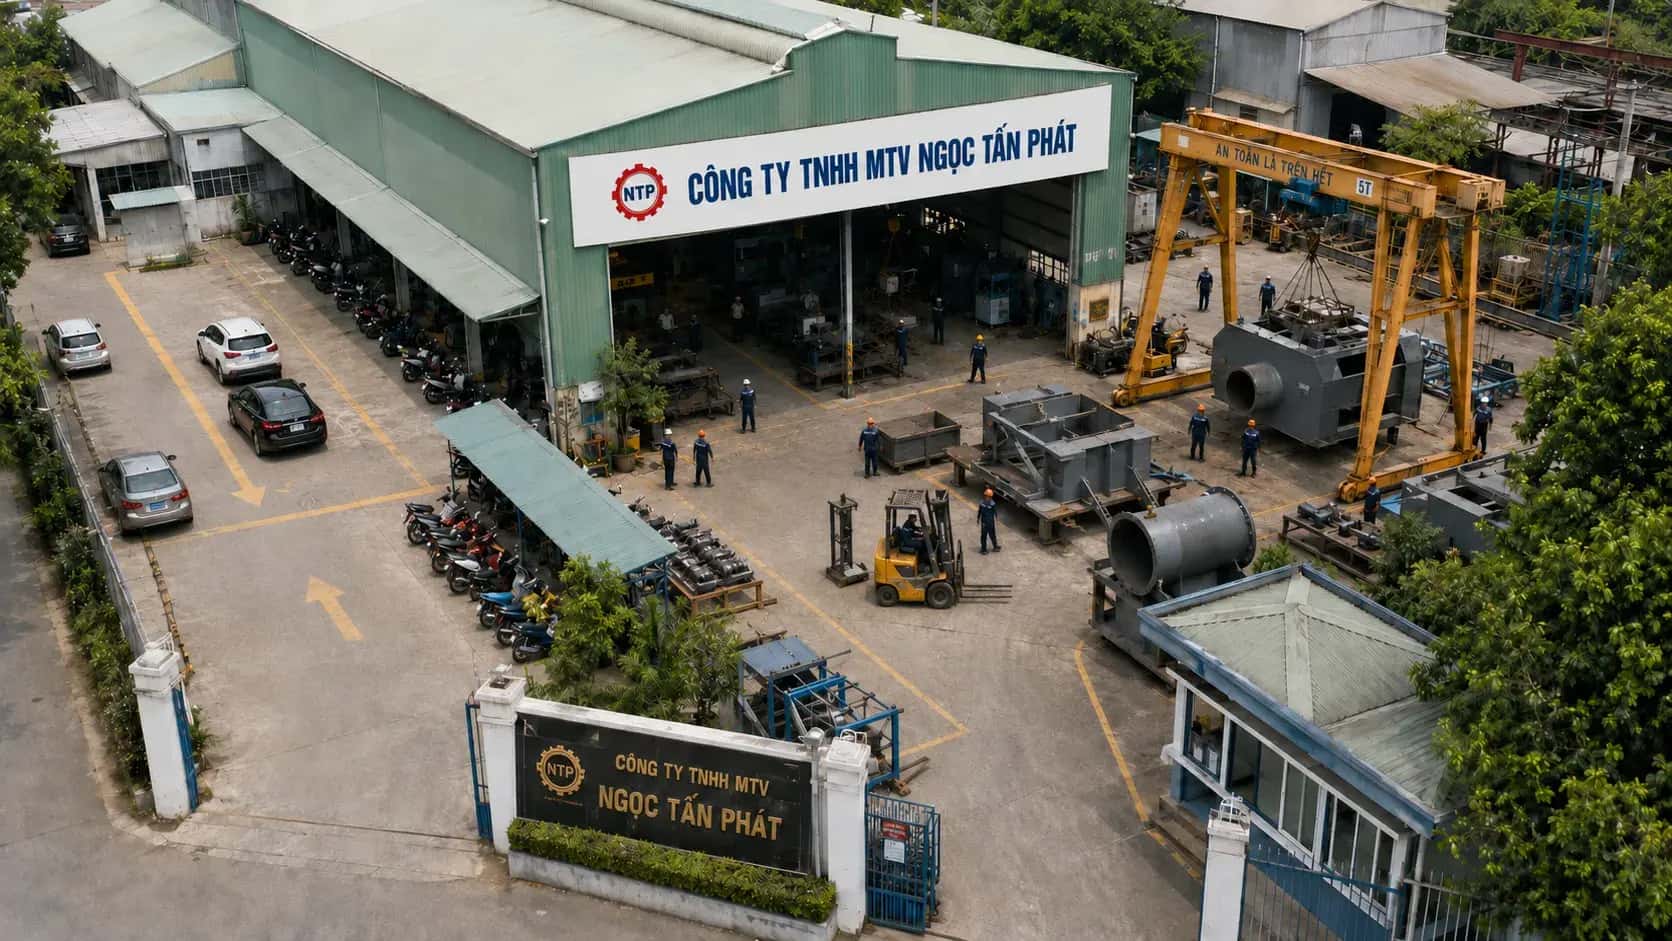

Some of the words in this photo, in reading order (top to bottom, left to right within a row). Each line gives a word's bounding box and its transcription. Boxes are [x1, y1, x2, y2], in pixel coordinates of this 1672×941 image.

[1216, 143, 1229, 159] AN
[688, 164, 752, 205] CÔNG
[760, 160, 790, 195] TY
[800, 151, 858, 189] TNHH
[866, 145, 910, 180] MTV
[919, 136, 975, 175] NGỌC
[982, 122, 1020, 164] TẤN
[1028, 119, 1077, 158] PHÁT
[623, 184, 656, 202] NTP
[1358, 180, 1372, 195] 5T
[547, 762, 575, 778] NTP
[615, 752, 658, 777] CÔNG
[663, 762, 683, 781] TY
[688, 767, 729, 790] TNHH
[735, 775, 769, 797] MTV
[598, 785, 659, 820] NGỌC
[667, 793, 712, 829] TẤN
[721, 808, 783, 841] PHÁT
